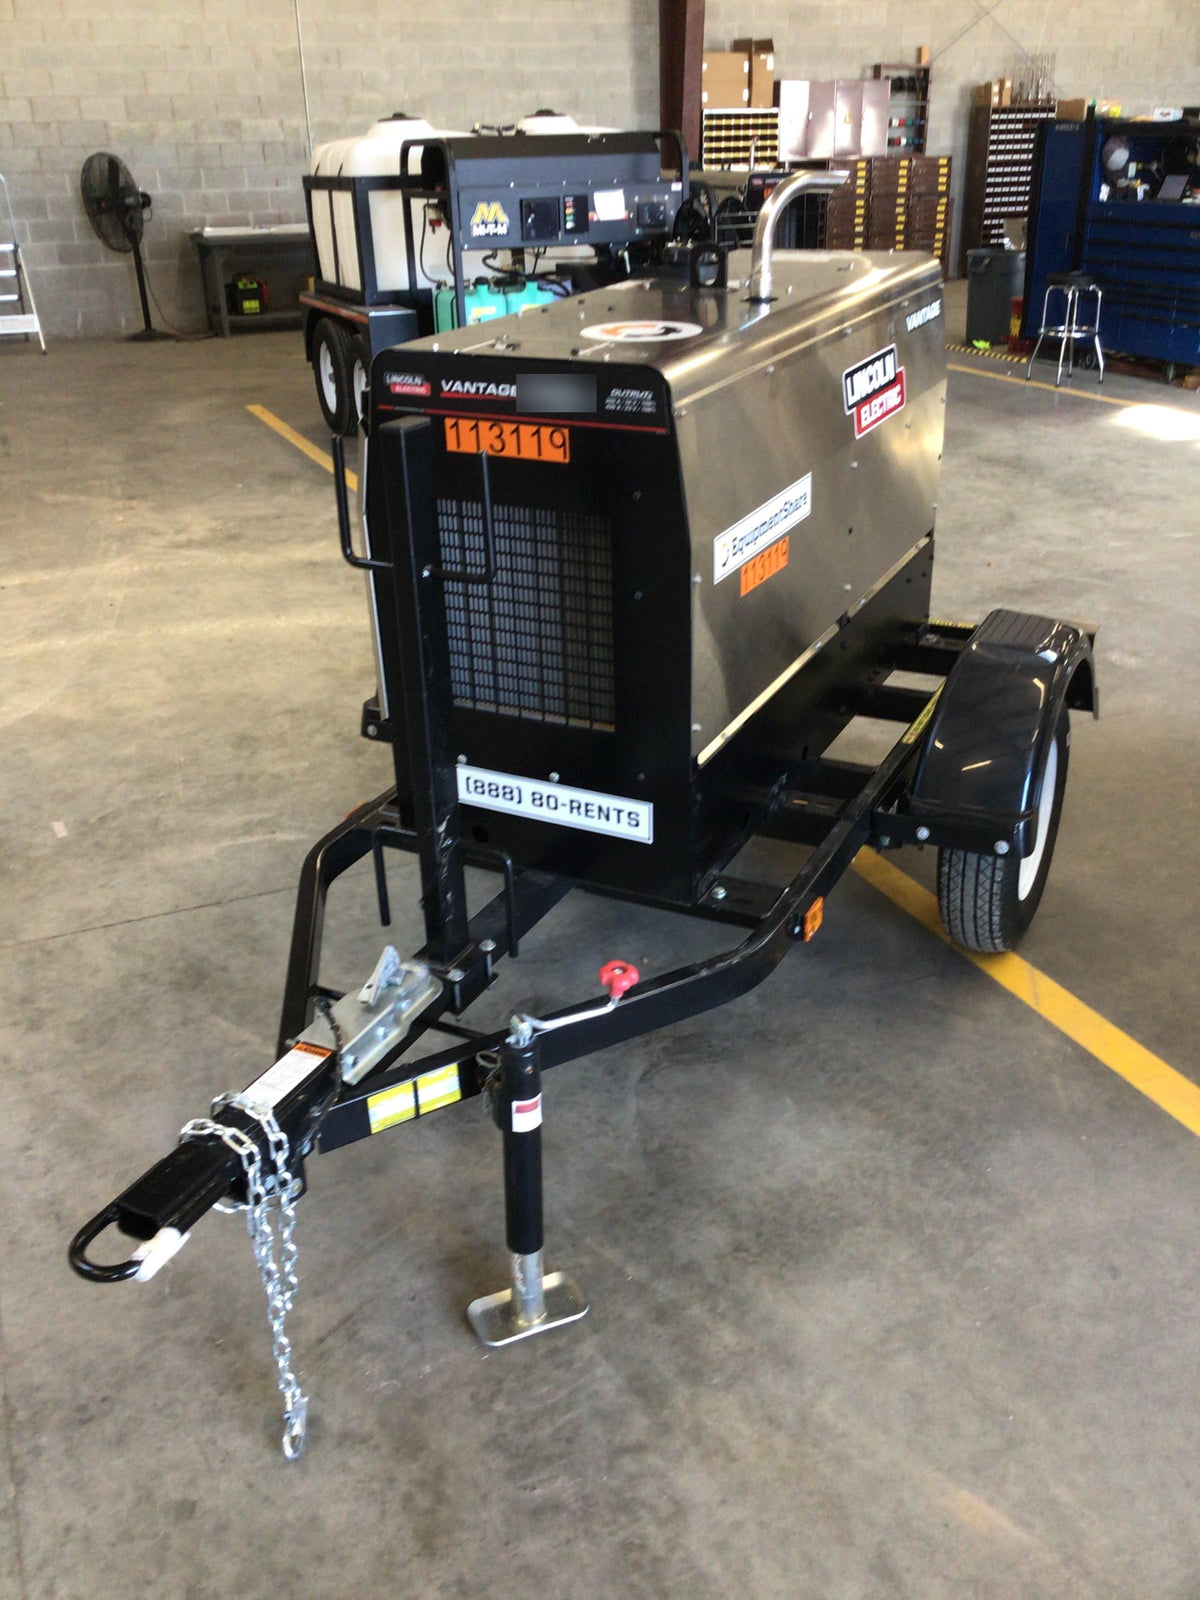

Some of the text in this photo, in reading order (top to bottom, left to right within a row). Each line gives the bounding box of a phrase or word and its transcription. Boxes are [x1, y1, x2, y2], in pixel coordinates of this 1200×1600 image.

[385, 373, 423, 385] LINCOLN
[845, 352, 895, 406] LINCOLN
[860, 384, 902, 429] ELECTRIC
[448, 418, 568, 460] 113119
[731, 491, 808, 557] EquipmentShare
[465, 775, 641, 829] (888) 80-RENTS
